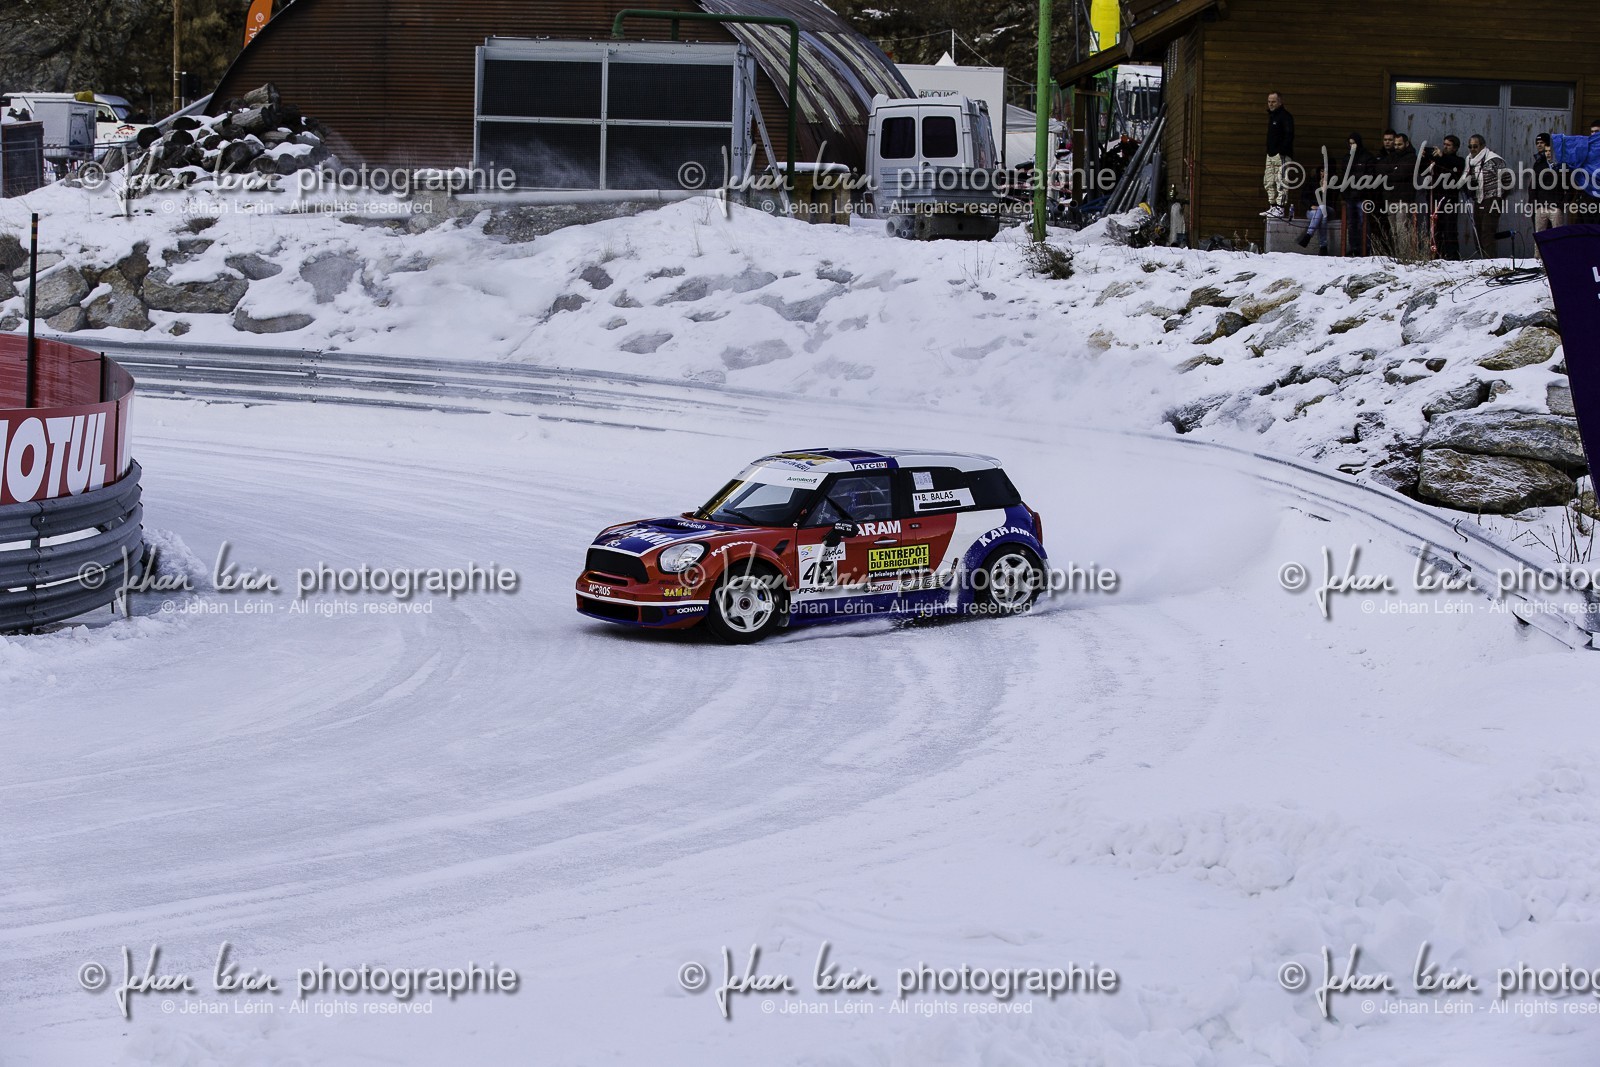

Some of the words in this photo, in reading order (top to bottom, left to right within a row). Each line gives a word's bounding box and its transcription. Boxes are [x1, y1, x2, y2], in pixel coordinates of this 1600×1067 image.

[0, 412, 107, 503] OTUL
[930, 491, 954, 500] BALAS
[856, 520, 901, 536] ARAM
[870, 545, 927, 562] L'ENTREPÔT
[870, 561, 882, 569] DU
[883, 557, 927, 568] BRICOLAGE
